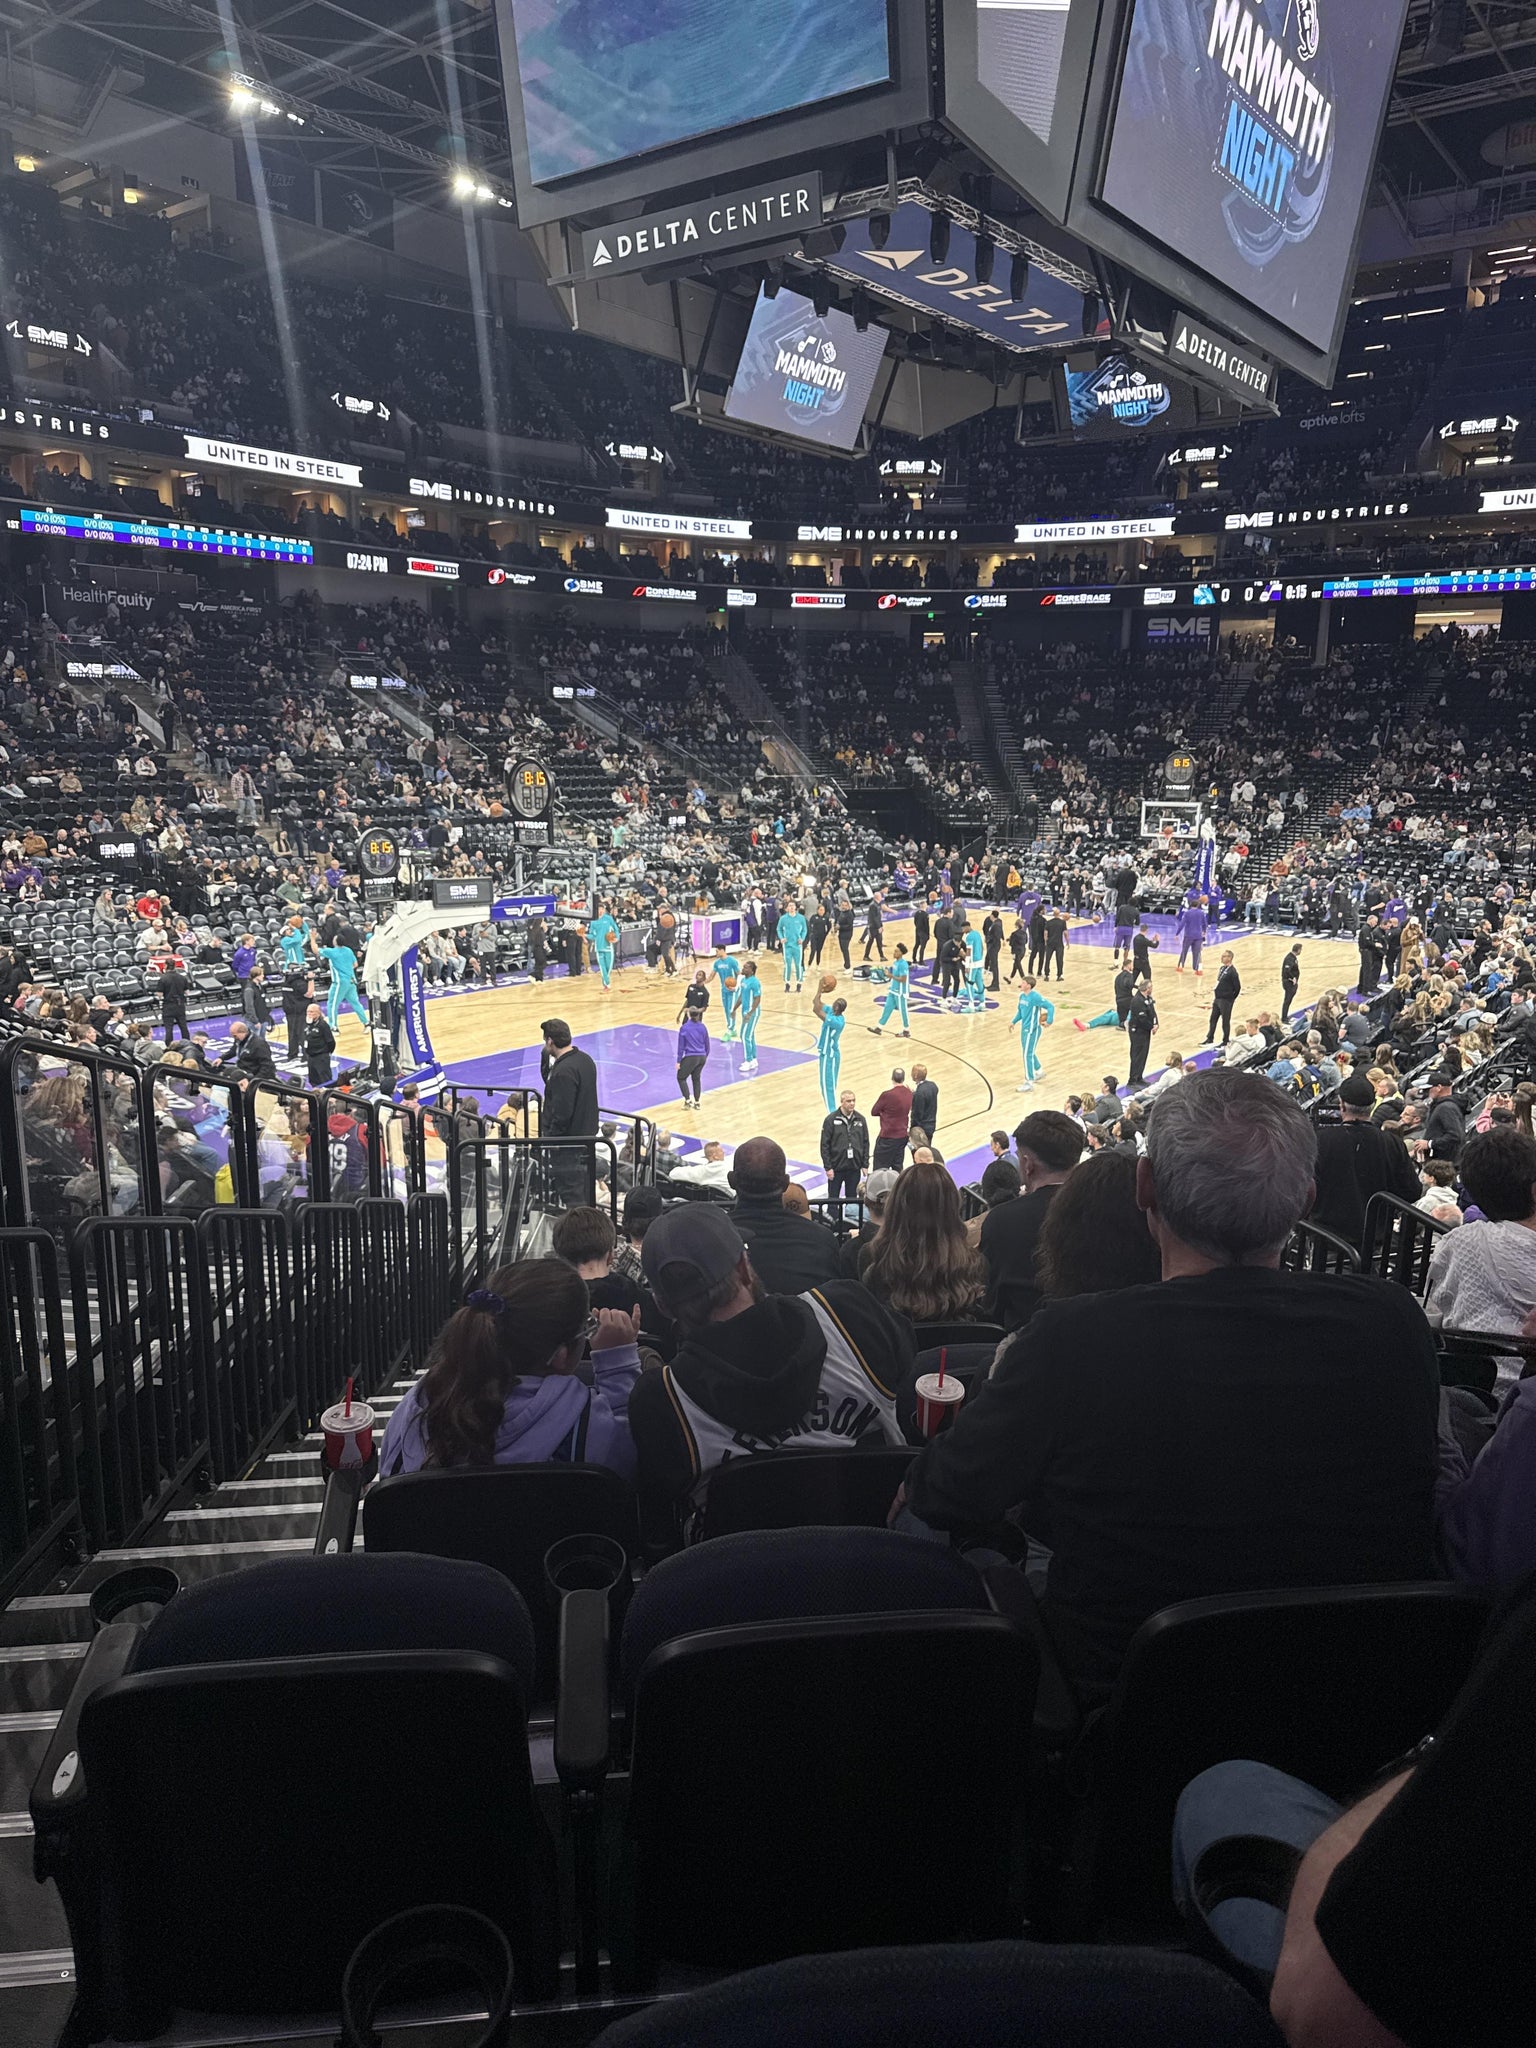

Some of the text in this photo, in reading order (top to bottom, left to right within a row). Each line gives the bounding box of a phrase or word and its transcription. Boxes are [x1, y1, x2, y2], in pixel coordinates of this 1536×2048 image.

[1208, 0, 1331, 164] MAMMOTH
[1220, 100, 1294, 213] NIGHT
[618, 189, 810, 258] DELTA CENTER
[916, 267, 1070, 336] DELTA
[775, 350, 846, 391] MAMMOTH
[1189, 336, 1268, 392] DELTA CENTER
[783, 378, 825, 409] NIGHT
[1097, 383, 1162, 406] MAMMOTH
[1112, 400, 1149, 417] NIGHT
[1300, 410, 1365, 430] aptive lofts
[208, 444, 344, 479] UNITED IN STEEL
[410, 478, 555, 515] SME INDUSTRIES
[7, 520, 19, 529] 1ST
[35, 513, 48, 522] 0/0
[84, 520, 98, 528] 0/0
[131, 525, 143, 533] 0/0
[622, 514, 735, 534] UNITED IN STEEL
[1225, 503, 1409, 529] SME INDUSTRIES
[35, 524, 49, 532] 0/0
[85, 530, 98, 538] 0/0
[131, 535, 144, 543] 0/0
[797, 525, 959, 541] SME INDUSTRIES
[1033, 521, 1156, 538] UNITED IN STEEL
[373, 555, 388, 573] PM
[62, 587, 152, 610] HealthEquity
[1221, 588, 1230, 602] 0
[1245, 587, 1253, 601] 0
[1286, 585, 1307, 599] 8:15
[1147, 617, 1211, 636] SME
[524, 771, 546, 786] 8:15
[370, 841, 391, 854] 8:15
[409, 967, 429, 1053] AMERICA FIRST
